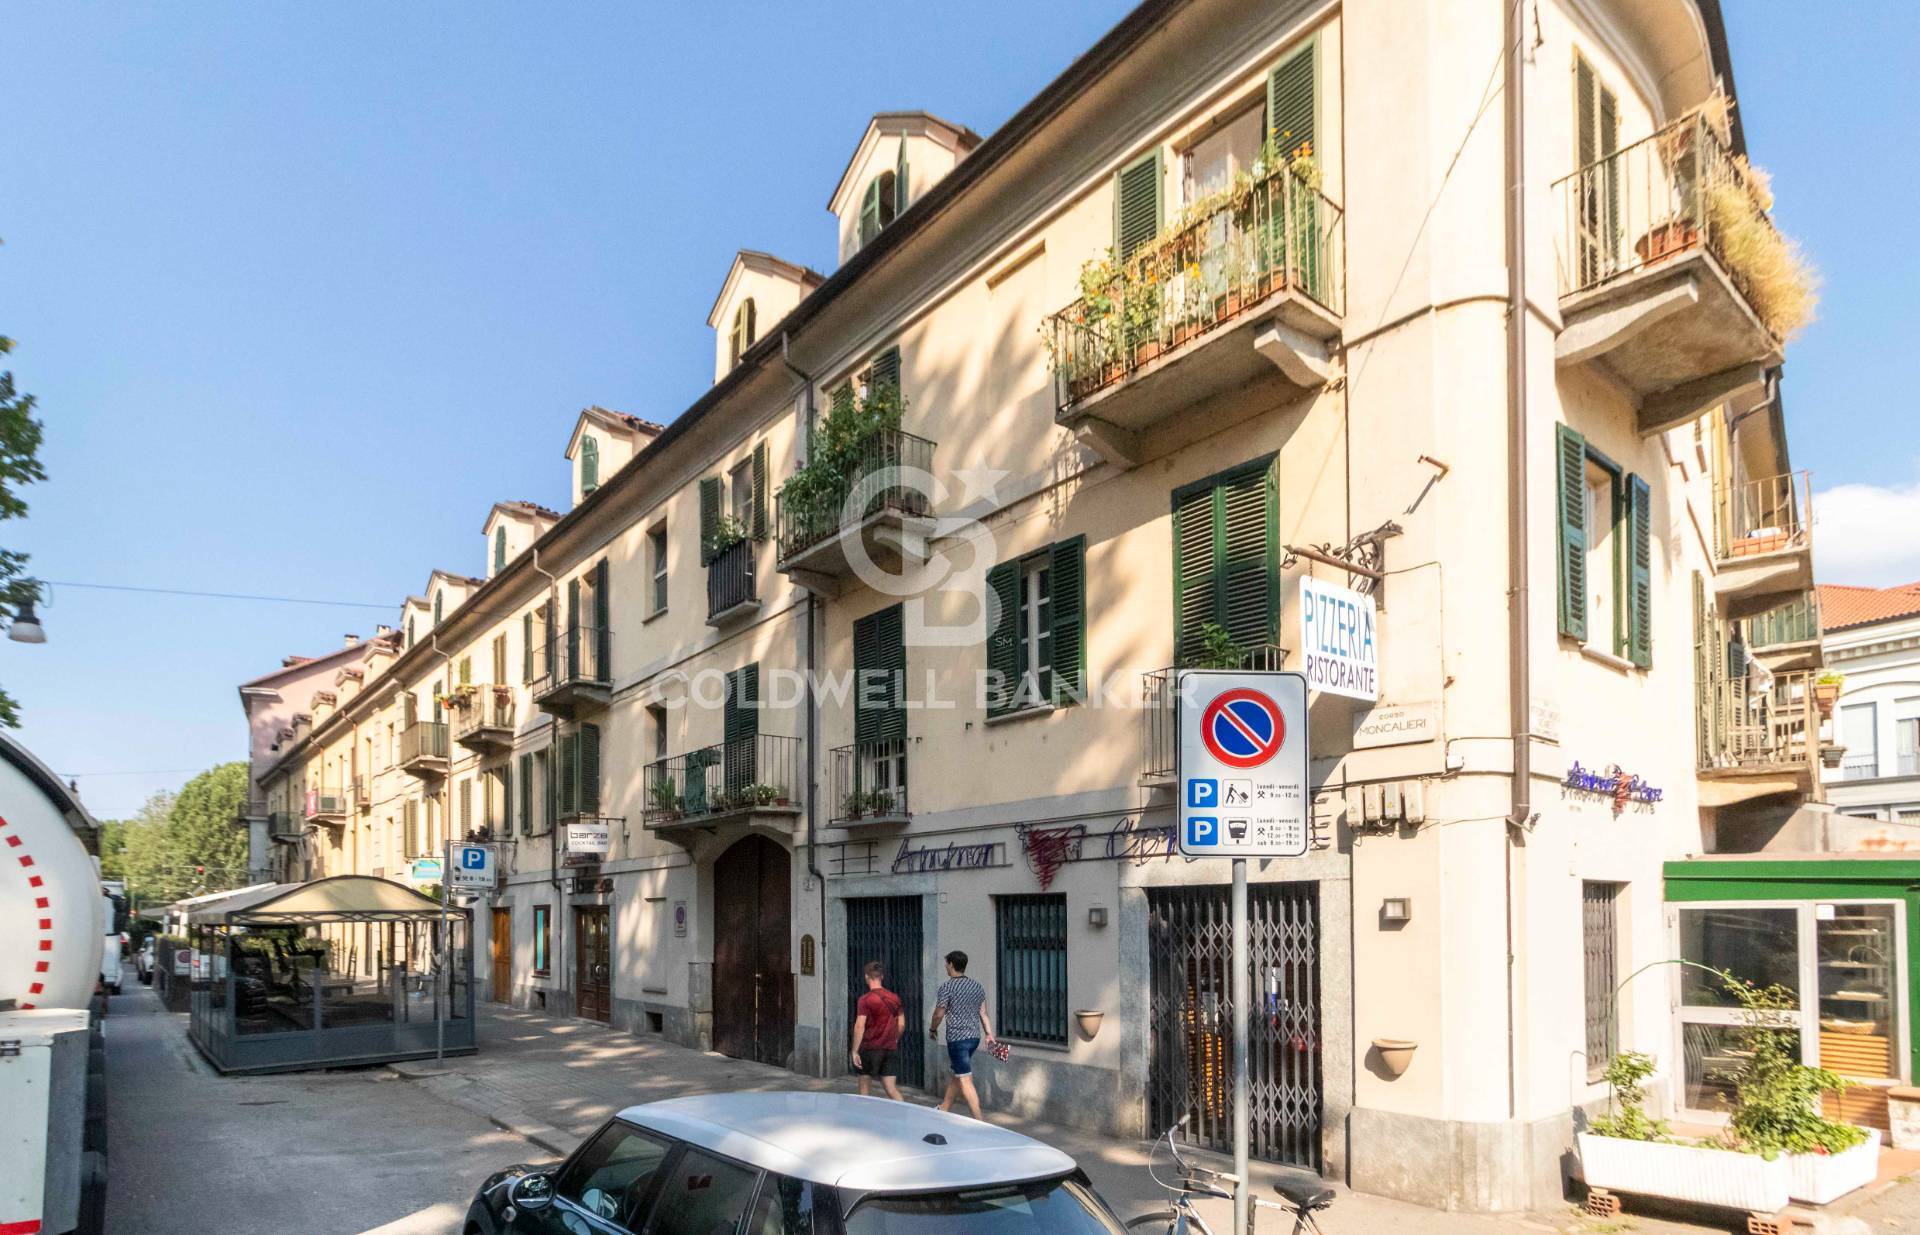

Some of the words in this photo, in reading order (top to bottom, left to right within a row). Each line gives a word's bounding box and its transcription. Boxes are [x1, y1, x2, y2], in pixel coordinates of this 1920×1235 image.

[1304, 589, 1374, 663] PIZZERIA
[1306, 654, 1374, 694] RISTORANTE
[1359, 718, 1426, 735] MONCALIERI
[1379, 711, 1405, 720] CORSO
[1194, 782, 1213, 804] P
[1194, 820, 1213, 842] P
[467, 850, 482, 867] P
